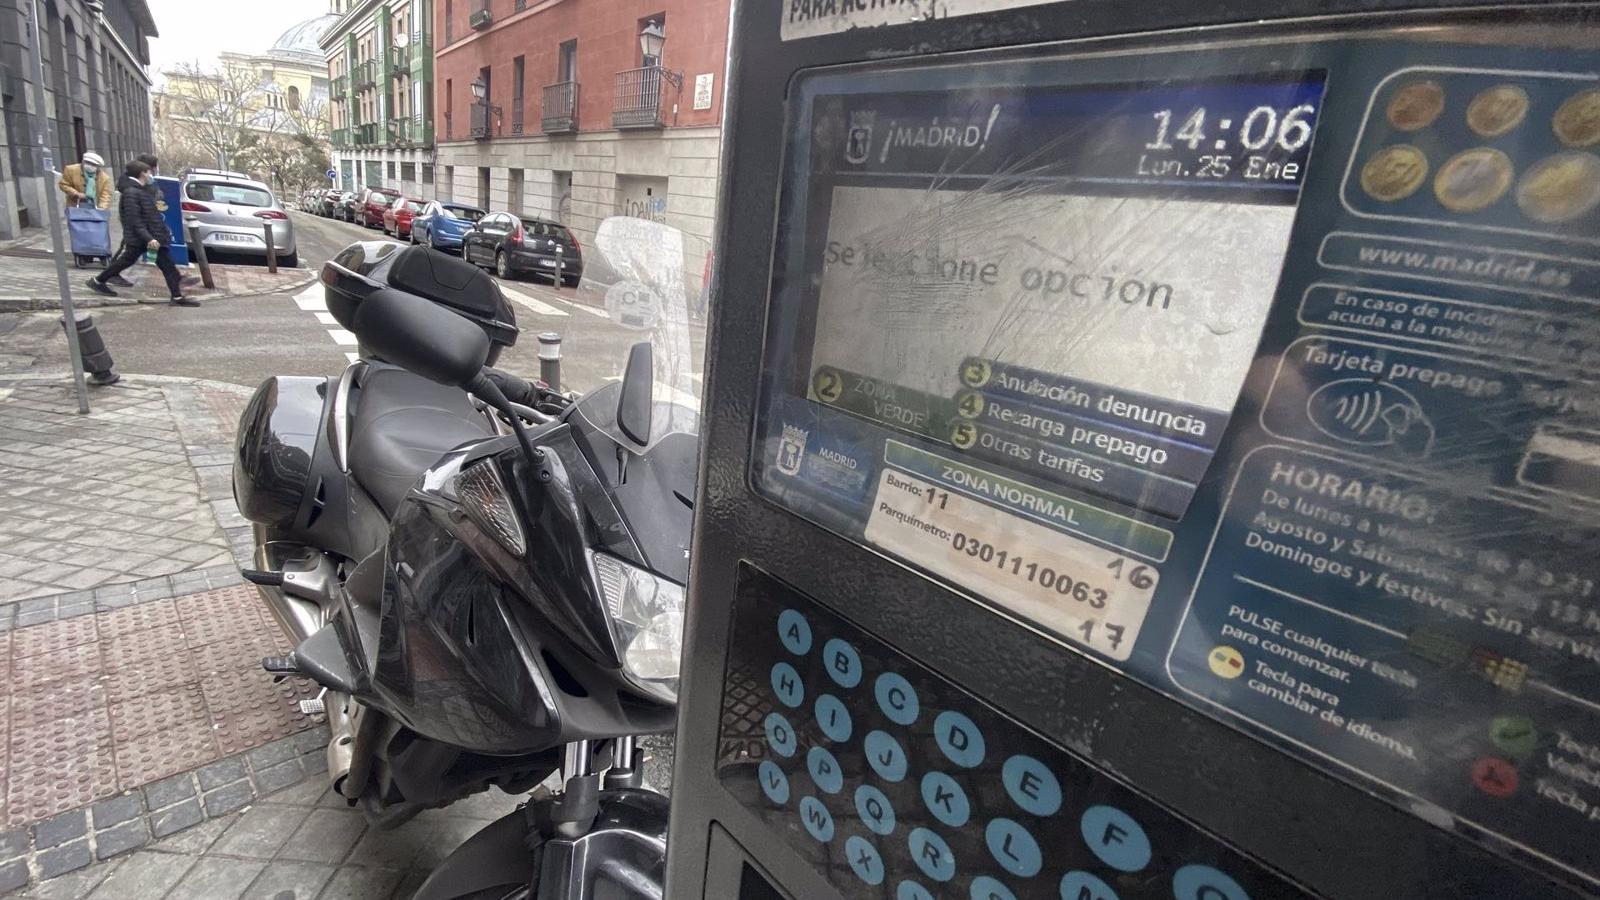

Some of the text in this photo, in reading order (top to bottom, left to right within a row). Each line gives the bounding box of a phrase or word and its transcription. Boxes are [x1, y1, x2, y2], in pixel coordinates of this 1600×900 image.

[1146, 105, 1315, 152] 14:06
[1244, 155, 1299, 180] Ene
[1358, 246, 1571, 287] www.madrid.es
[1328, 310, 1386, 329] acuda
[1391, 318, 1404, 331] a
[1407, 315, 1427, 334] la
[1333, 290, 1359, 307] En
[1362, 297, 1408, 314] caso
[1413, 302, 1440, 319] de
[821, 369, 837, 398] 2
[1304, 344, 1504, 398] Tarjeta prepago
[968, 362, 985, 384] 3
[1098, 395, 1208, 438] denuncia
[956, 423, 1104, 483] 5 Otras tarifas
[962, 394, 1168, 465] 4 Recarga prepago
[820, 447, 857, 469] MADRID
[886, 474, 922, 497] Barrio:
[925, 487, 950, 510] 11
[942, 466, 1080, 526] ZONA NORMAL
[1262, 488, 1290, 510] De
[1294, 497, 1352, 528] lunes
[1356, 518, 1370, 533] a
[880, 502, 1108, 609] Parquímetro: 0301110063
[1253, 511, 1327, 546] Agosto
[1330, 537, 1345, 553] y
[1245, 531, 1352, 579] Domingos
[1356, 569, 1372, 587] y
[1482, 607, 1524, 635] Sin
[1221, 623, 1351, 684] para comenzar.
[1228, 604, 1283, 636] PULSE
[1284, 626, 1368, 668] cualquier
[1248, 677, 1319, 715] cambiar
[1320, 708, 1345, 728] de
[1255, 659, 1340, 707] Tecla para
[787, 623, 1129, 846] A B C D E F
[780, 673, 794, 696] H
[879, 750, 893, 767] J
[935, 784, 954, 813] K
[1003, 833, 1020, 862] L
[768, 770, 872, 873] V W X
[773, 725, 941, 869] O P Q R
